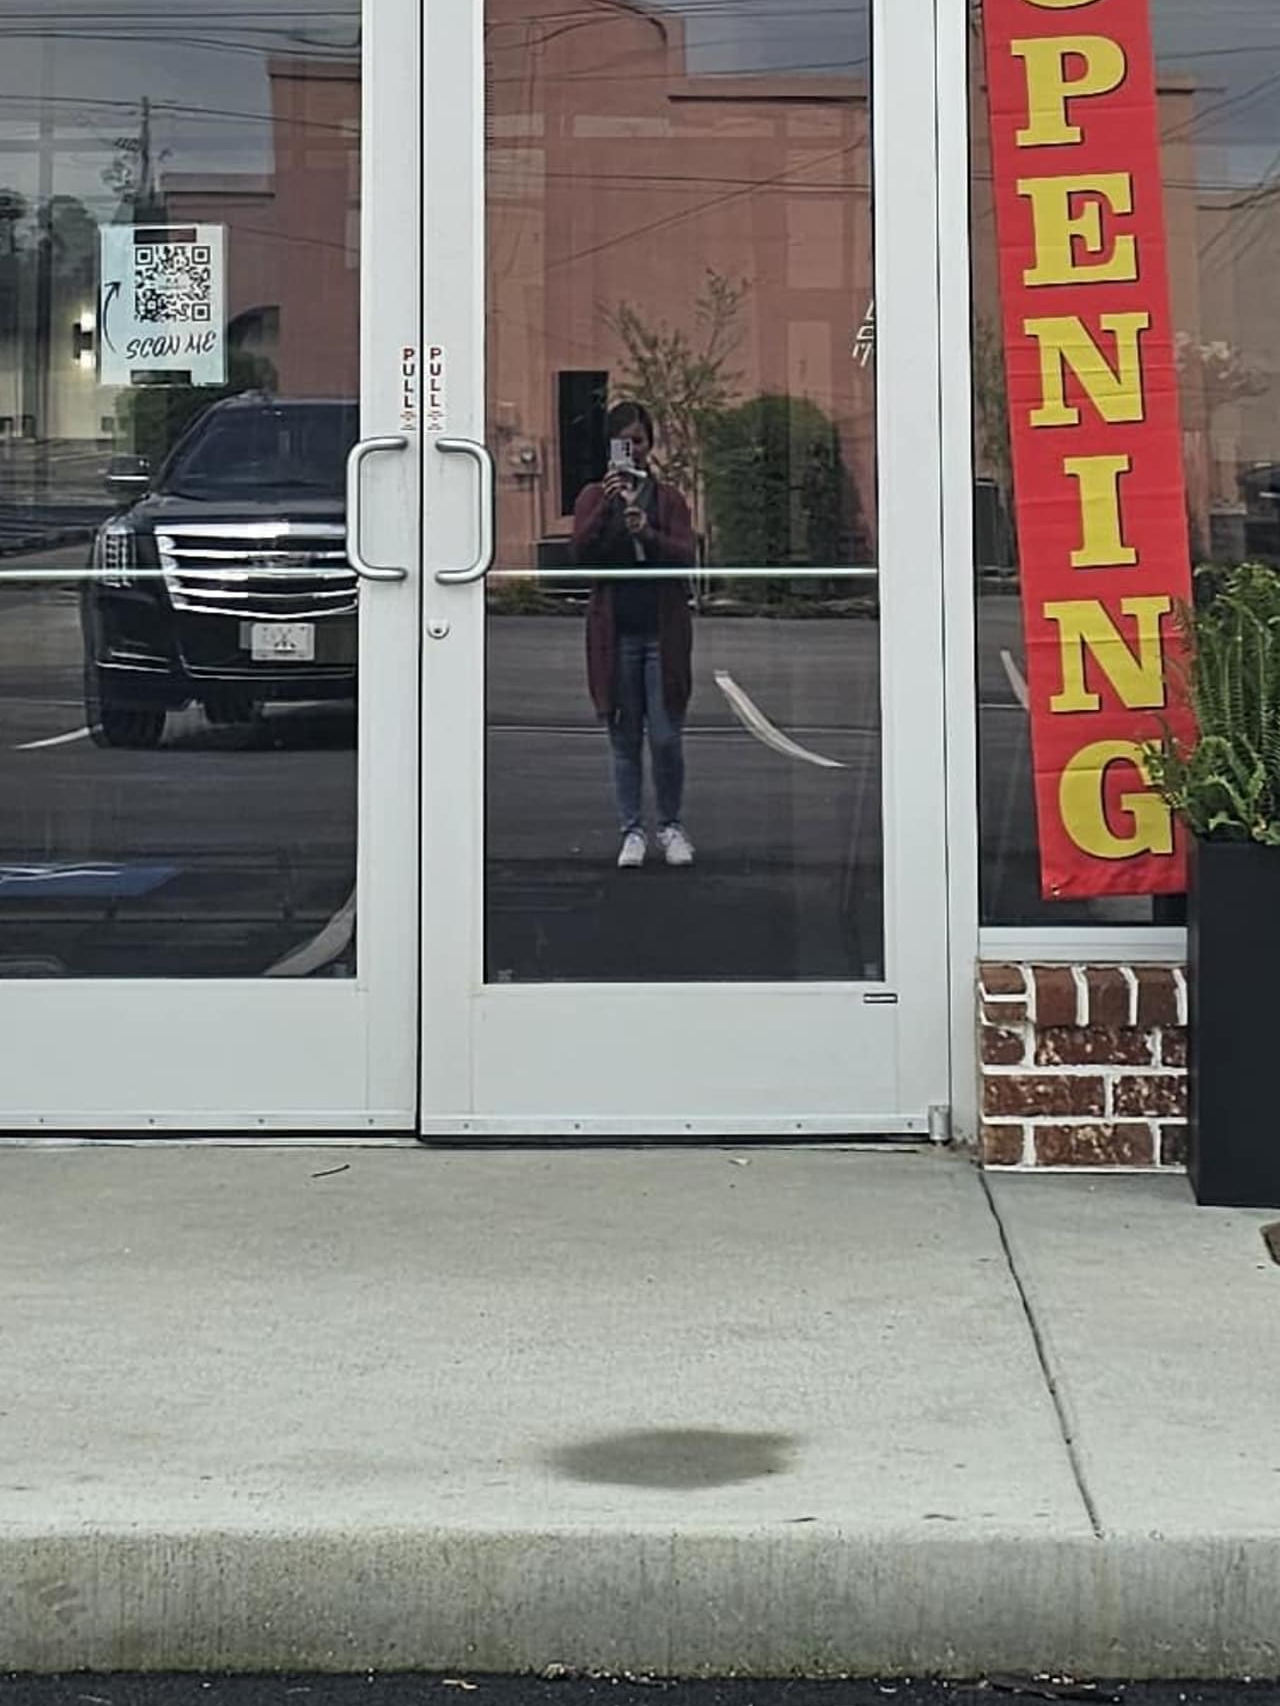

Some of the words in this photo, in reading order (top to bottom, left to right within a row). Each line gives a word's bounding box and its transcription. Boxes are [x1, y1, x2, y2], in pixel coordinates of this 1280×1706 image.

[184, 330, 216, 354] ME
[403, 348, 415, 409] PULL
[430, 347, 442, 408] PULL
